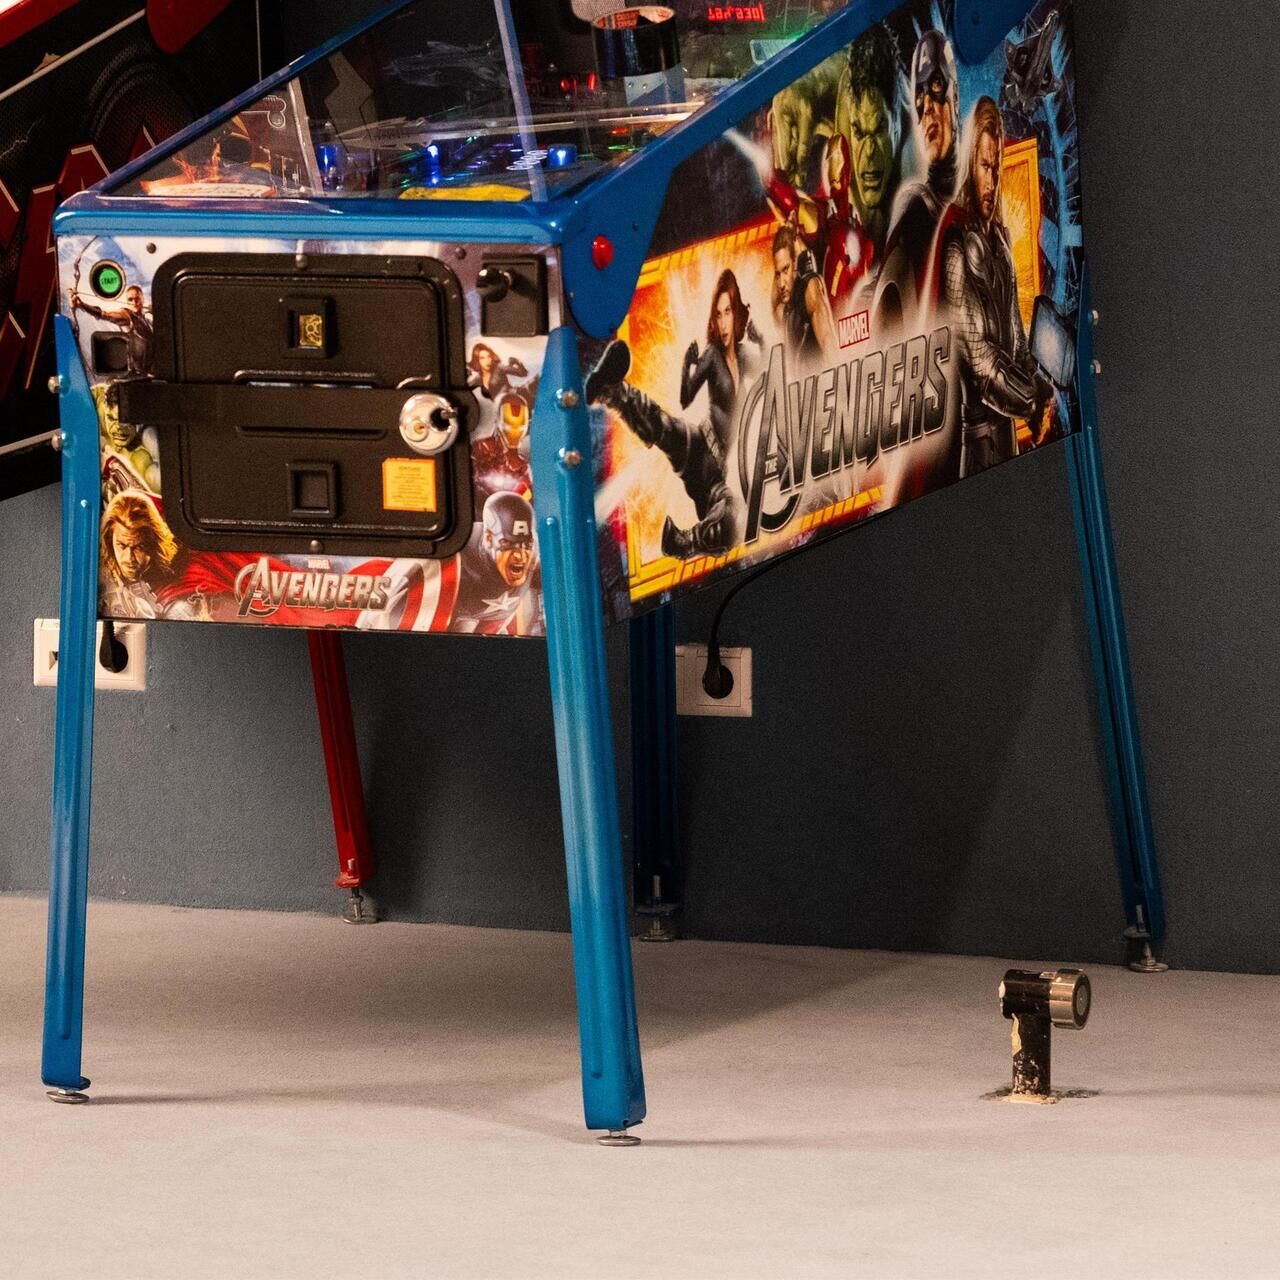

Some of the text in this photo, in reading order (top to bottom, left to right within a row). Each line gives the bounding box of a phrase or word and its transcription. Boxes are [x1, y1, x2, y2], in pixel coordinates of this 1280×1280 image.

[839, 312, 869, 347] MARVEL
[738, 325, 952, 544] THE AVENGERS
[235, 557, 392, 617] AVENGERS
